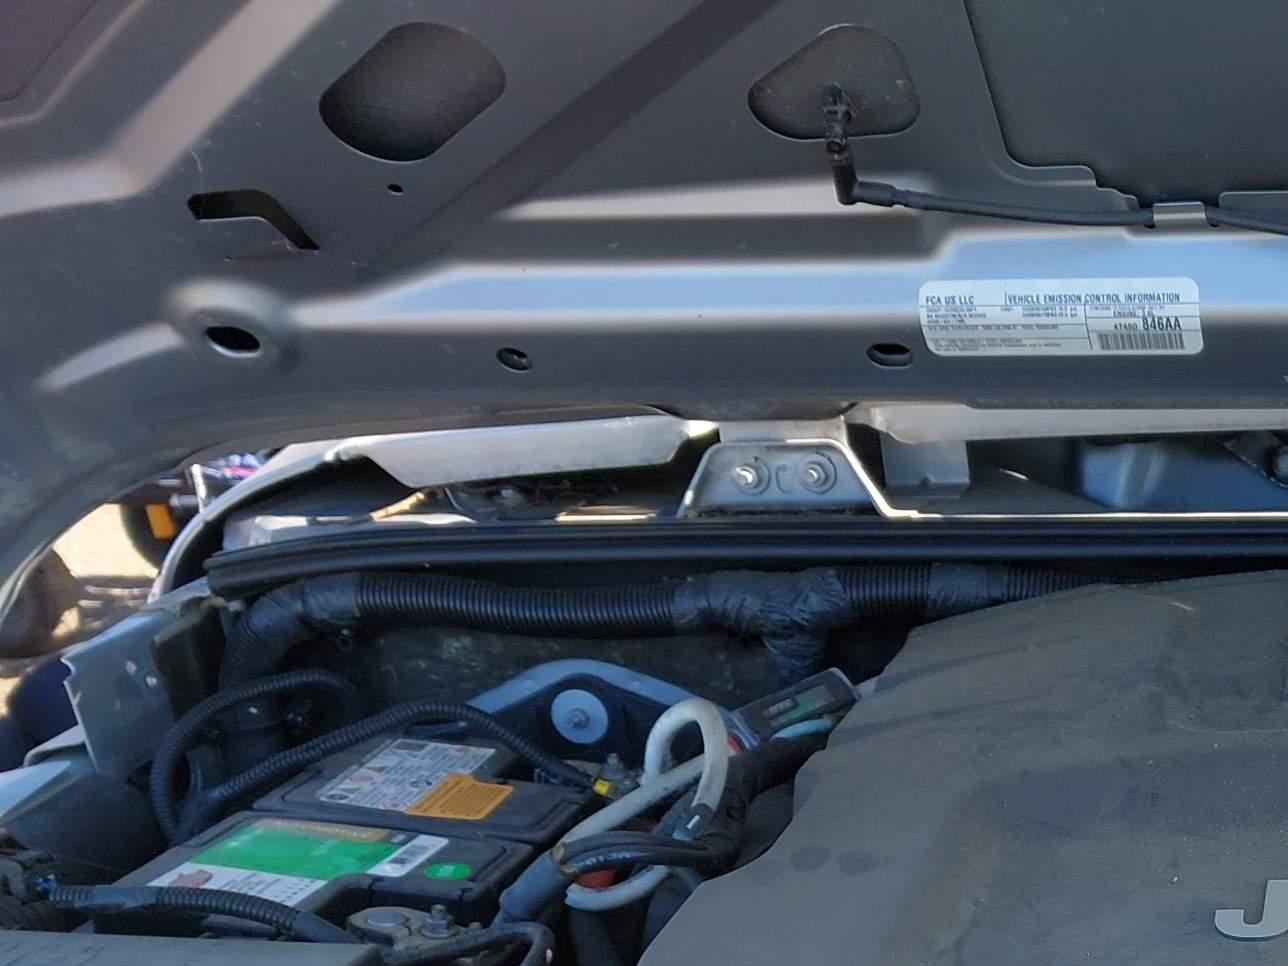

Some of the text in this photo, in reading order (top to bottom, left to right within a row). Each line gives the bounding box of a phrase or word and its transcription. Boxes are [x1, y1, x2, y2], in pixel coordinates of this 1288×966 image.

[925, 295, 975, 305] FCA US LLC
[1007, 292, 1181, 304] VEHICLE EMISSION CONTROL INFORMATION
[1141, 316, 1182, 331] 846AA
